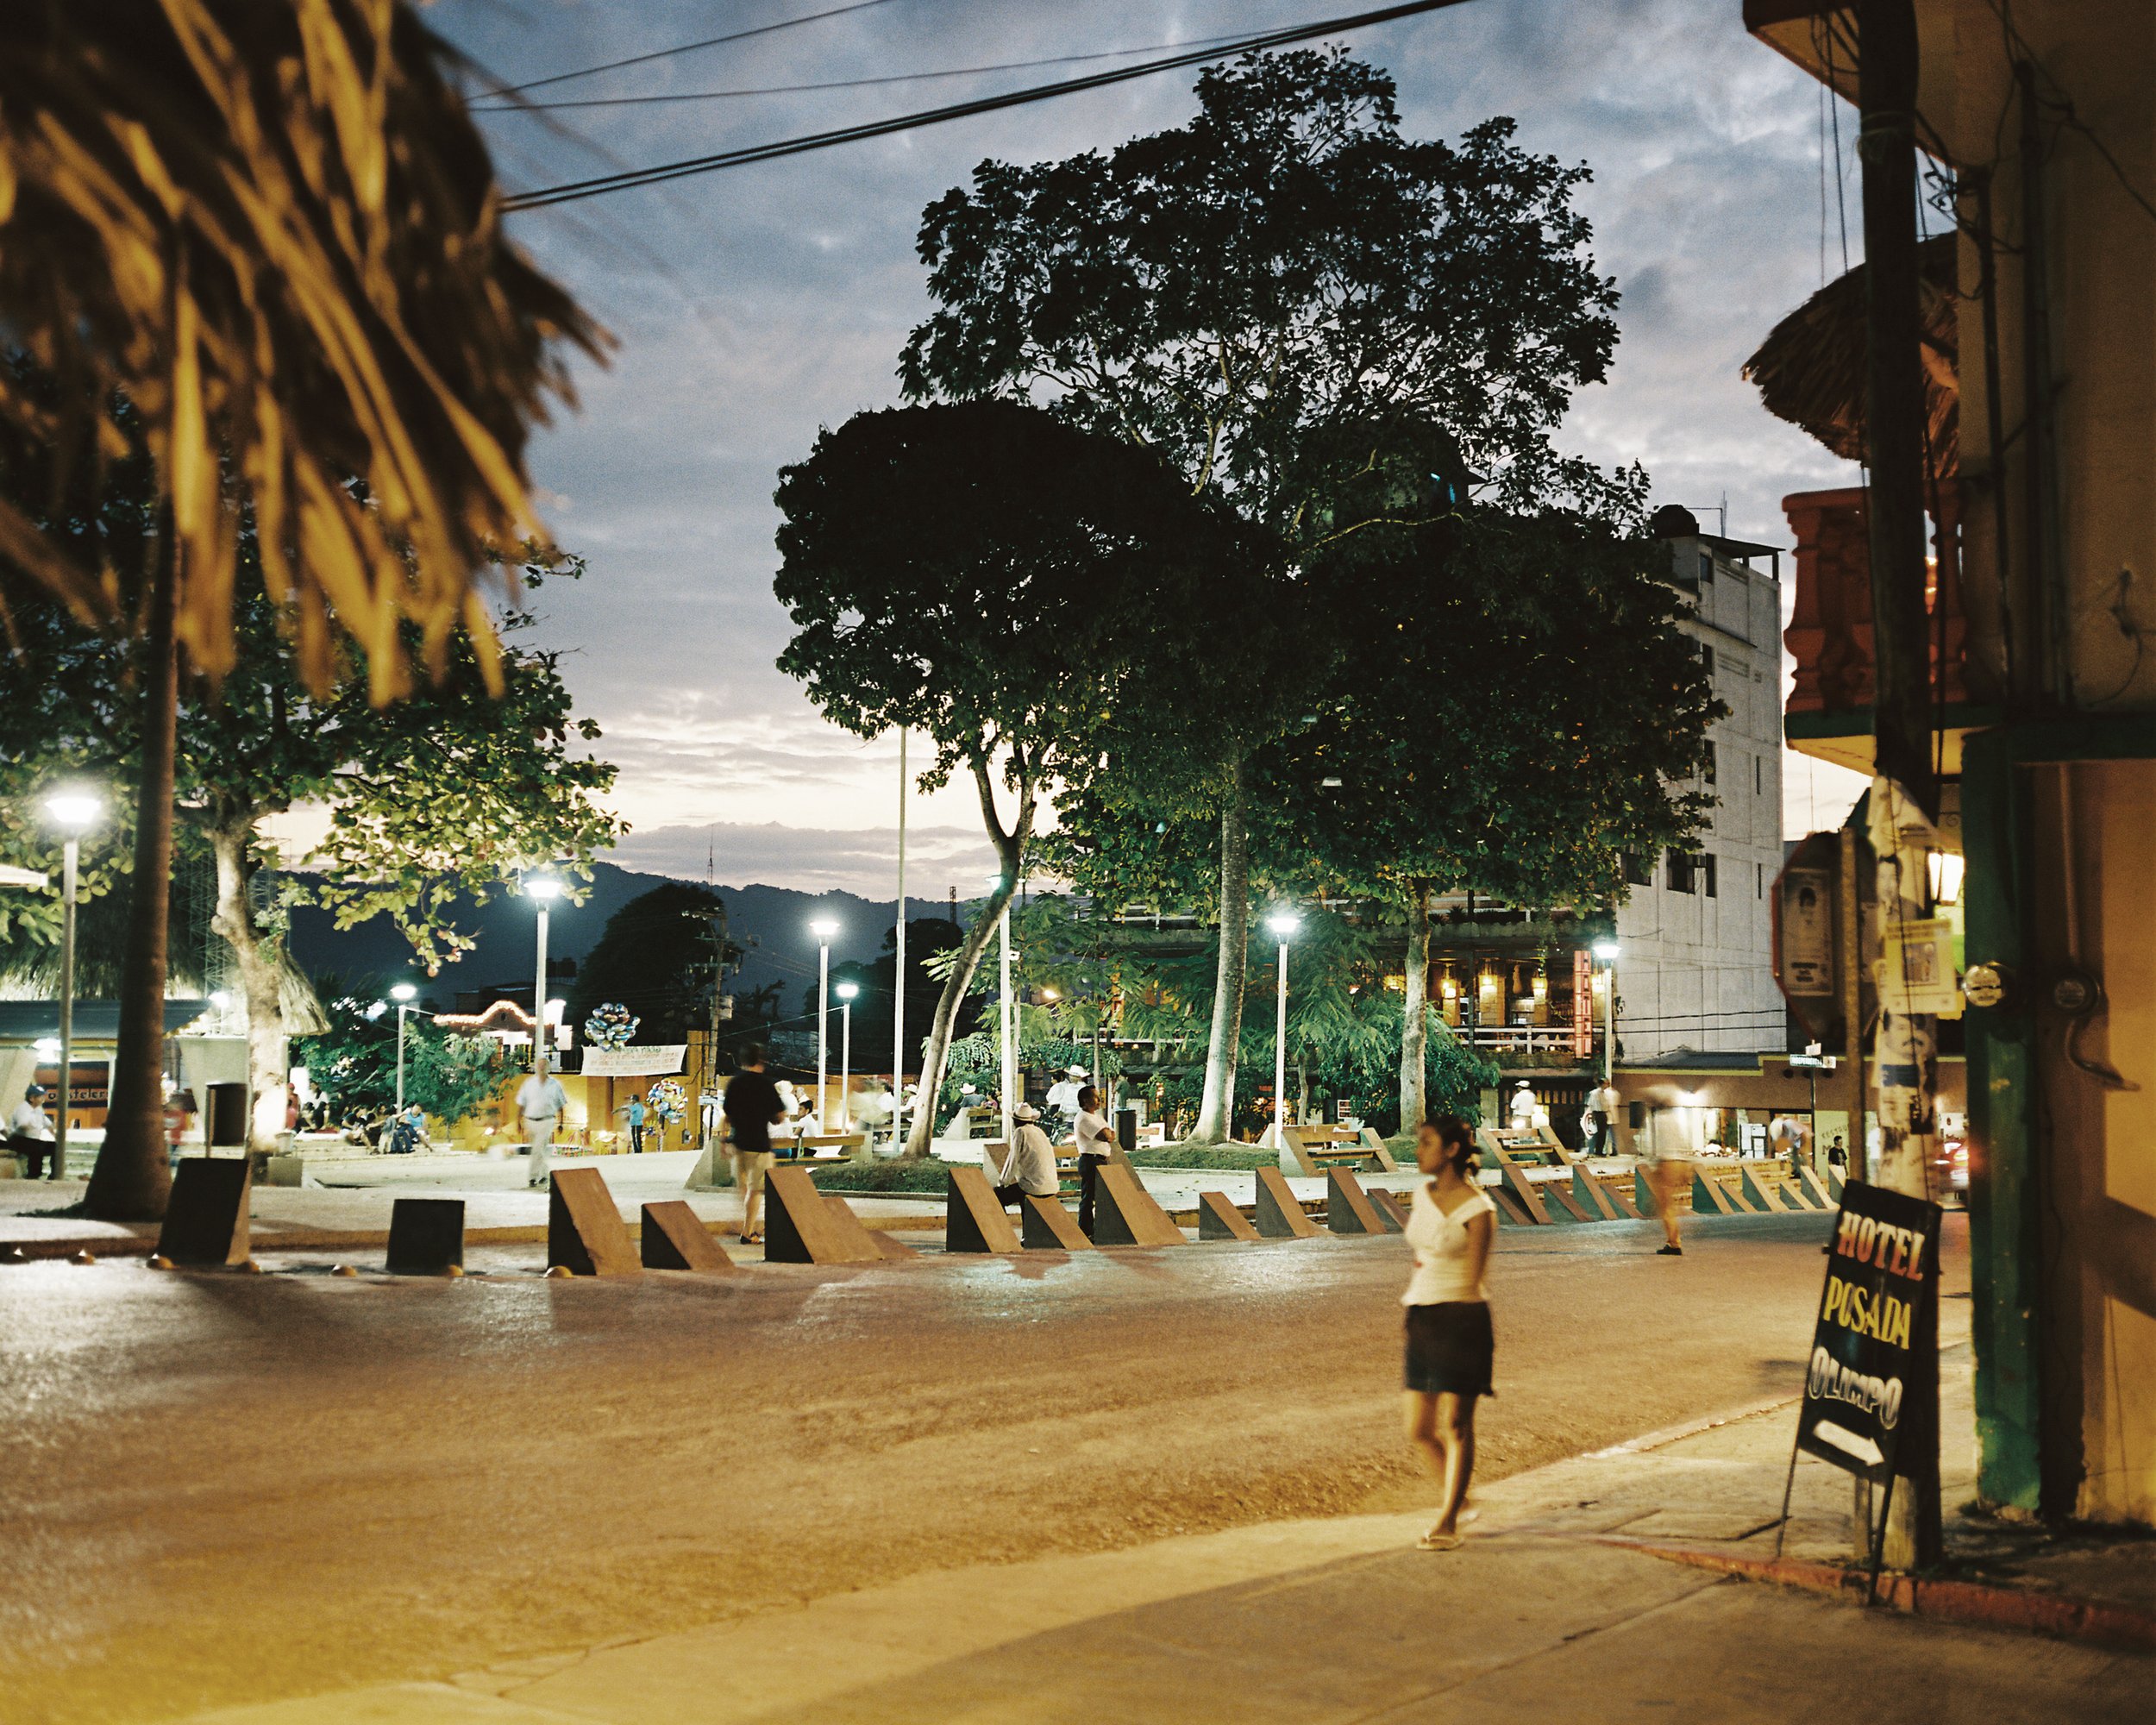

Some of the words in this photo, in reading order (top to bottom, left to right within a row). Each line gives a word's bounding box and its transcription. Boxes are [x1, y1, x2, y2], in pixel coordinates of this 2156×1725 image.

[1837, 1211, 1926, 1282] HOTEL
[1823, 1276, 1912, 1351] POSADA
[1808, 1346, 1903, 1431] OLIMPO
